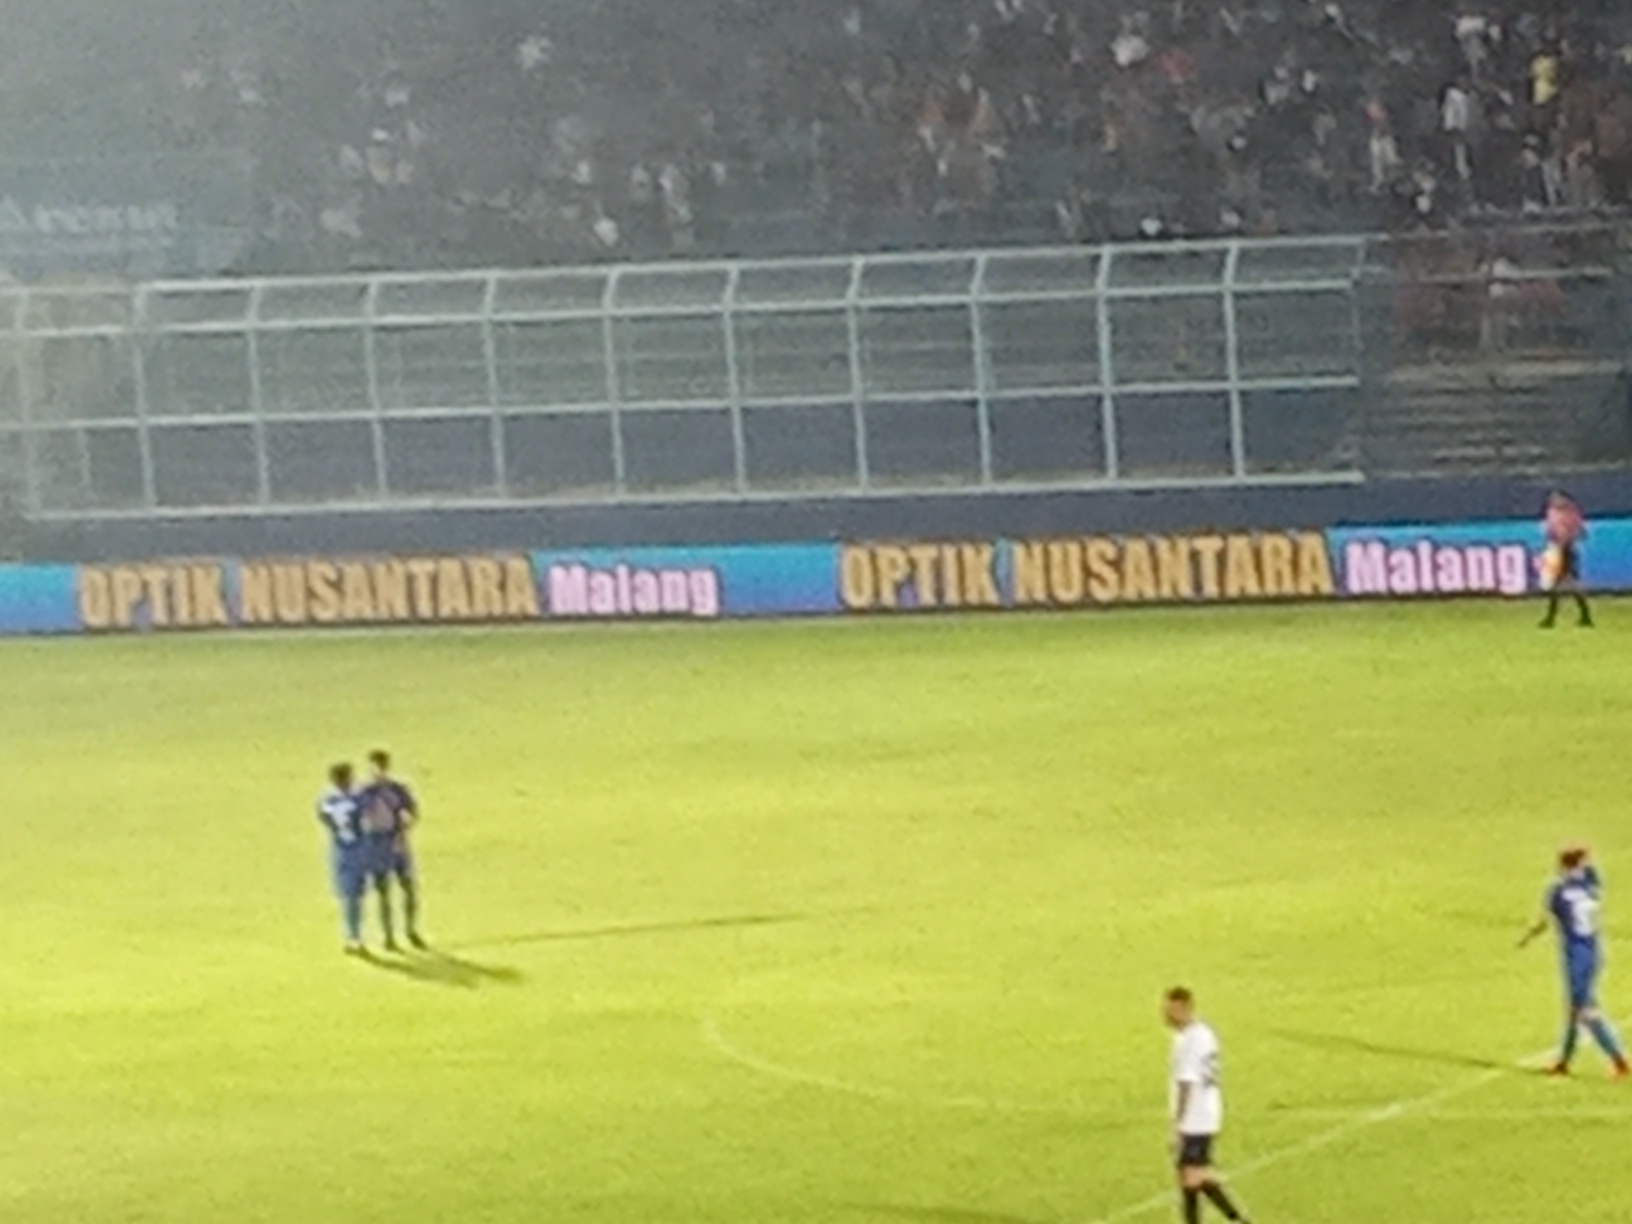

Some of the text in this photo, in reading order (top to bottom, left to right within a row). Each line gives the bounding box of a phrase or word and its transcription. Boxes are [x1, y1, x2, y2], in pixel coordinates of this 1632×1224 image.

[82, 555, 717, 625] OPTIK NUSANTARA Malang
[843, 534, 1525, 605] OPTIK NUSANTARA Malang
